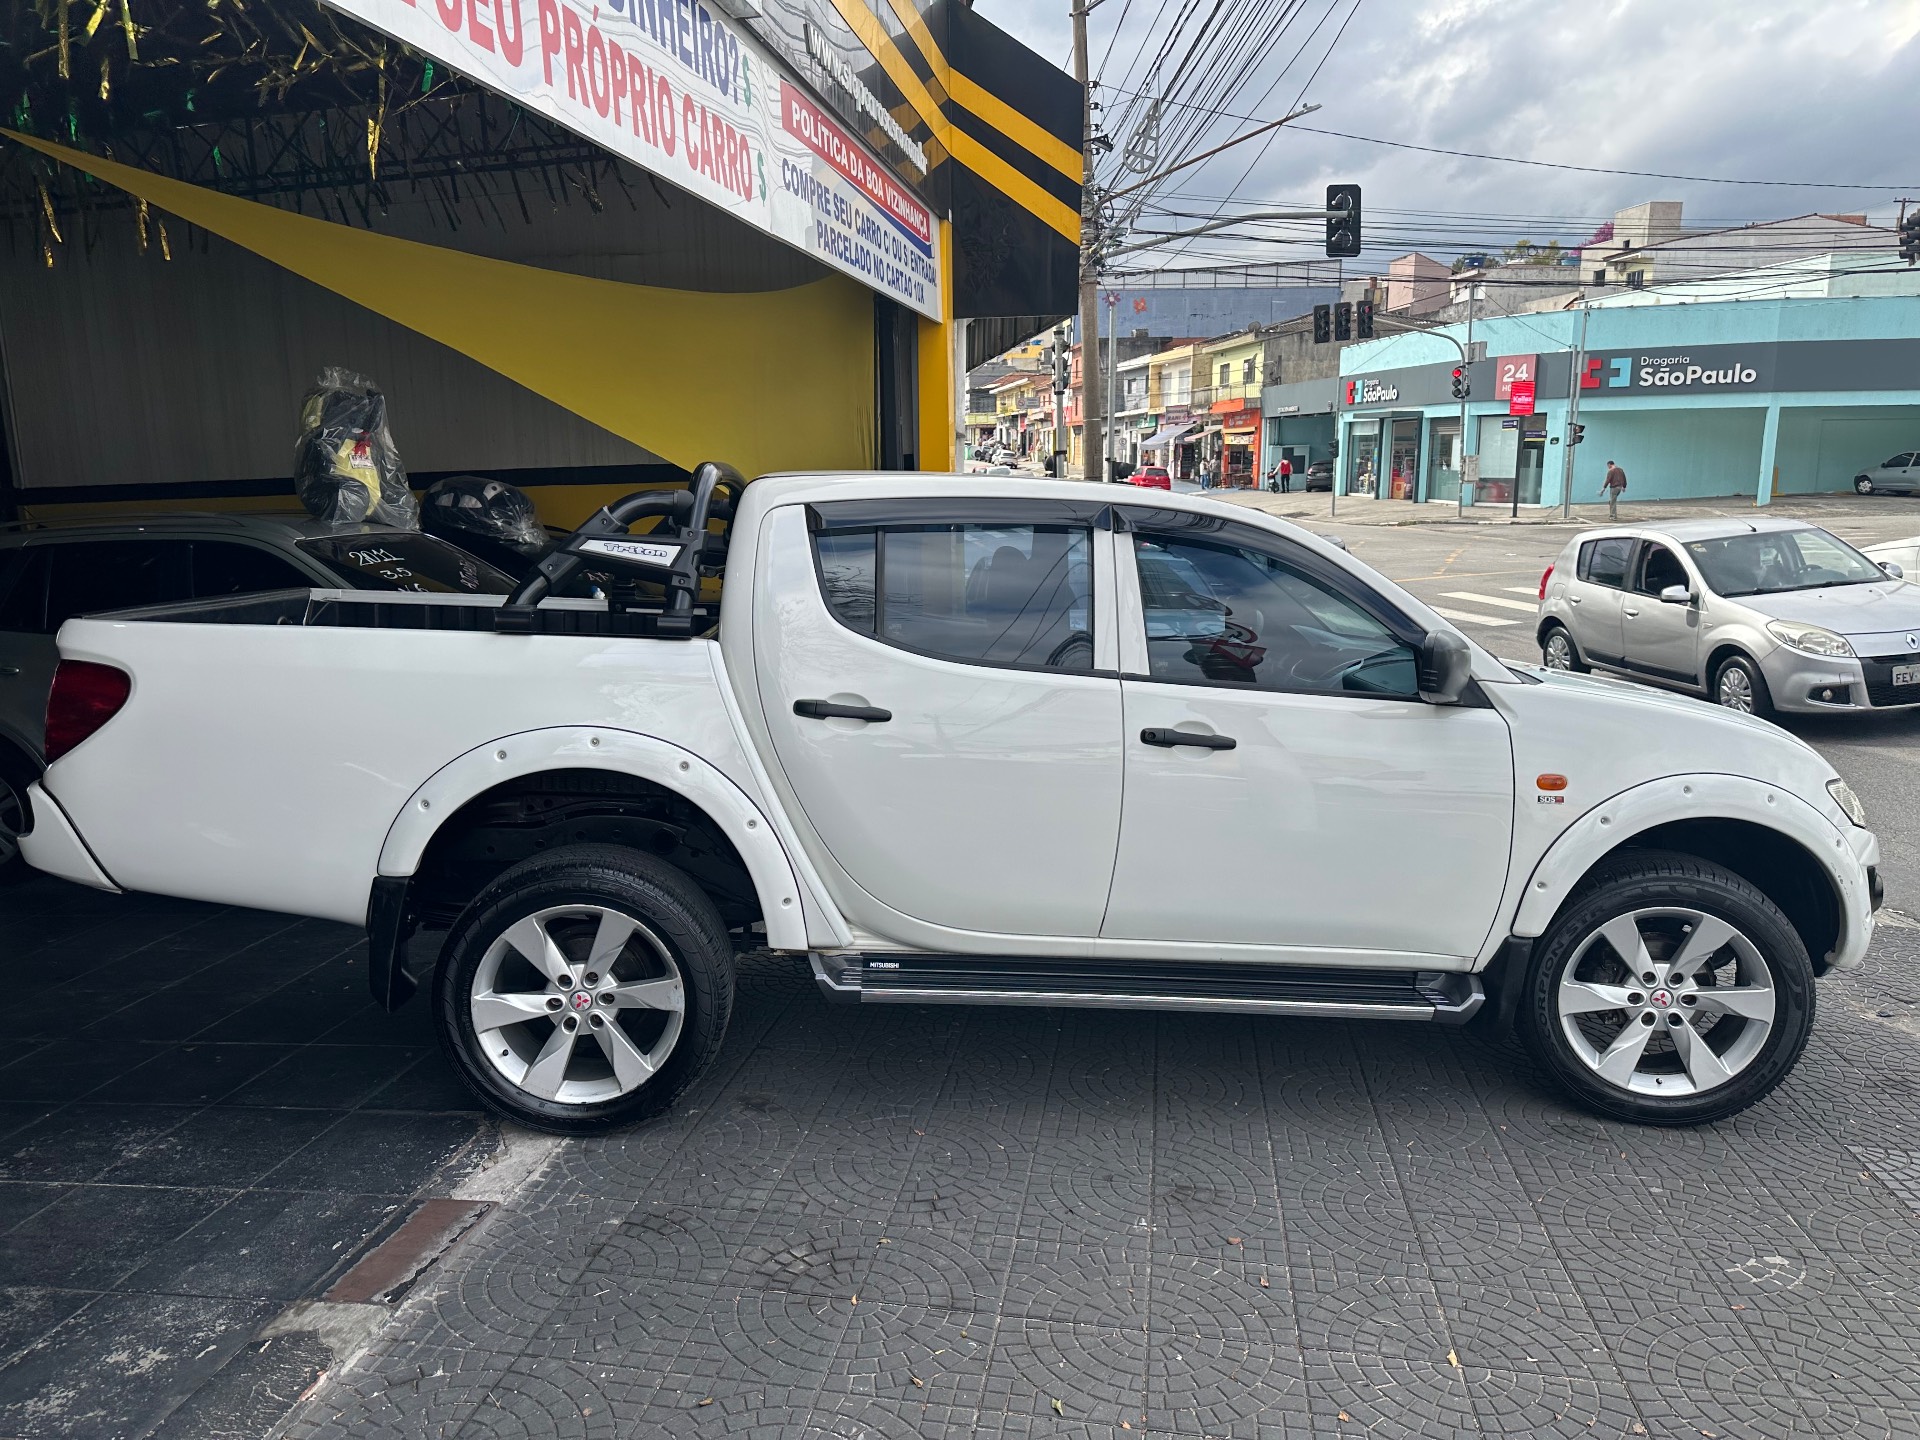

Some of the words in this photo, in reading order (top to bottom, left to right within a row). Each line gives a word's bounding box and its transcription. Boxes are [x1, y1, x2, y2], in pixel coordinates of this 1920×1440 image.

[538, 0, 676, 157] PRÓPRIO
[683, 93, 752, 202] CARRO
[791, 98, 848, 170] POLÍTICA
[850, 150, 864, 183] DA
[866, 163, 884, 201] BOA
[885, 183, 928, 238] VIZINHANÇA
[782, 157, 831, 216] COMPRE
[833, 192, 852, 229] SEU
[855, 208, 882, 248] CARRO
[892, 236, 902, 263] OU
[816, 218, 871, 275] PARCELADO
[873, 255, 884, 283] NO
[1502, 363, 1528, 382] 24
[1638, 363, 1757, 387] SãoPaulo
[1640, 355, 1690, 367] Drogaria
[603, 543, 667, 557] Triton
